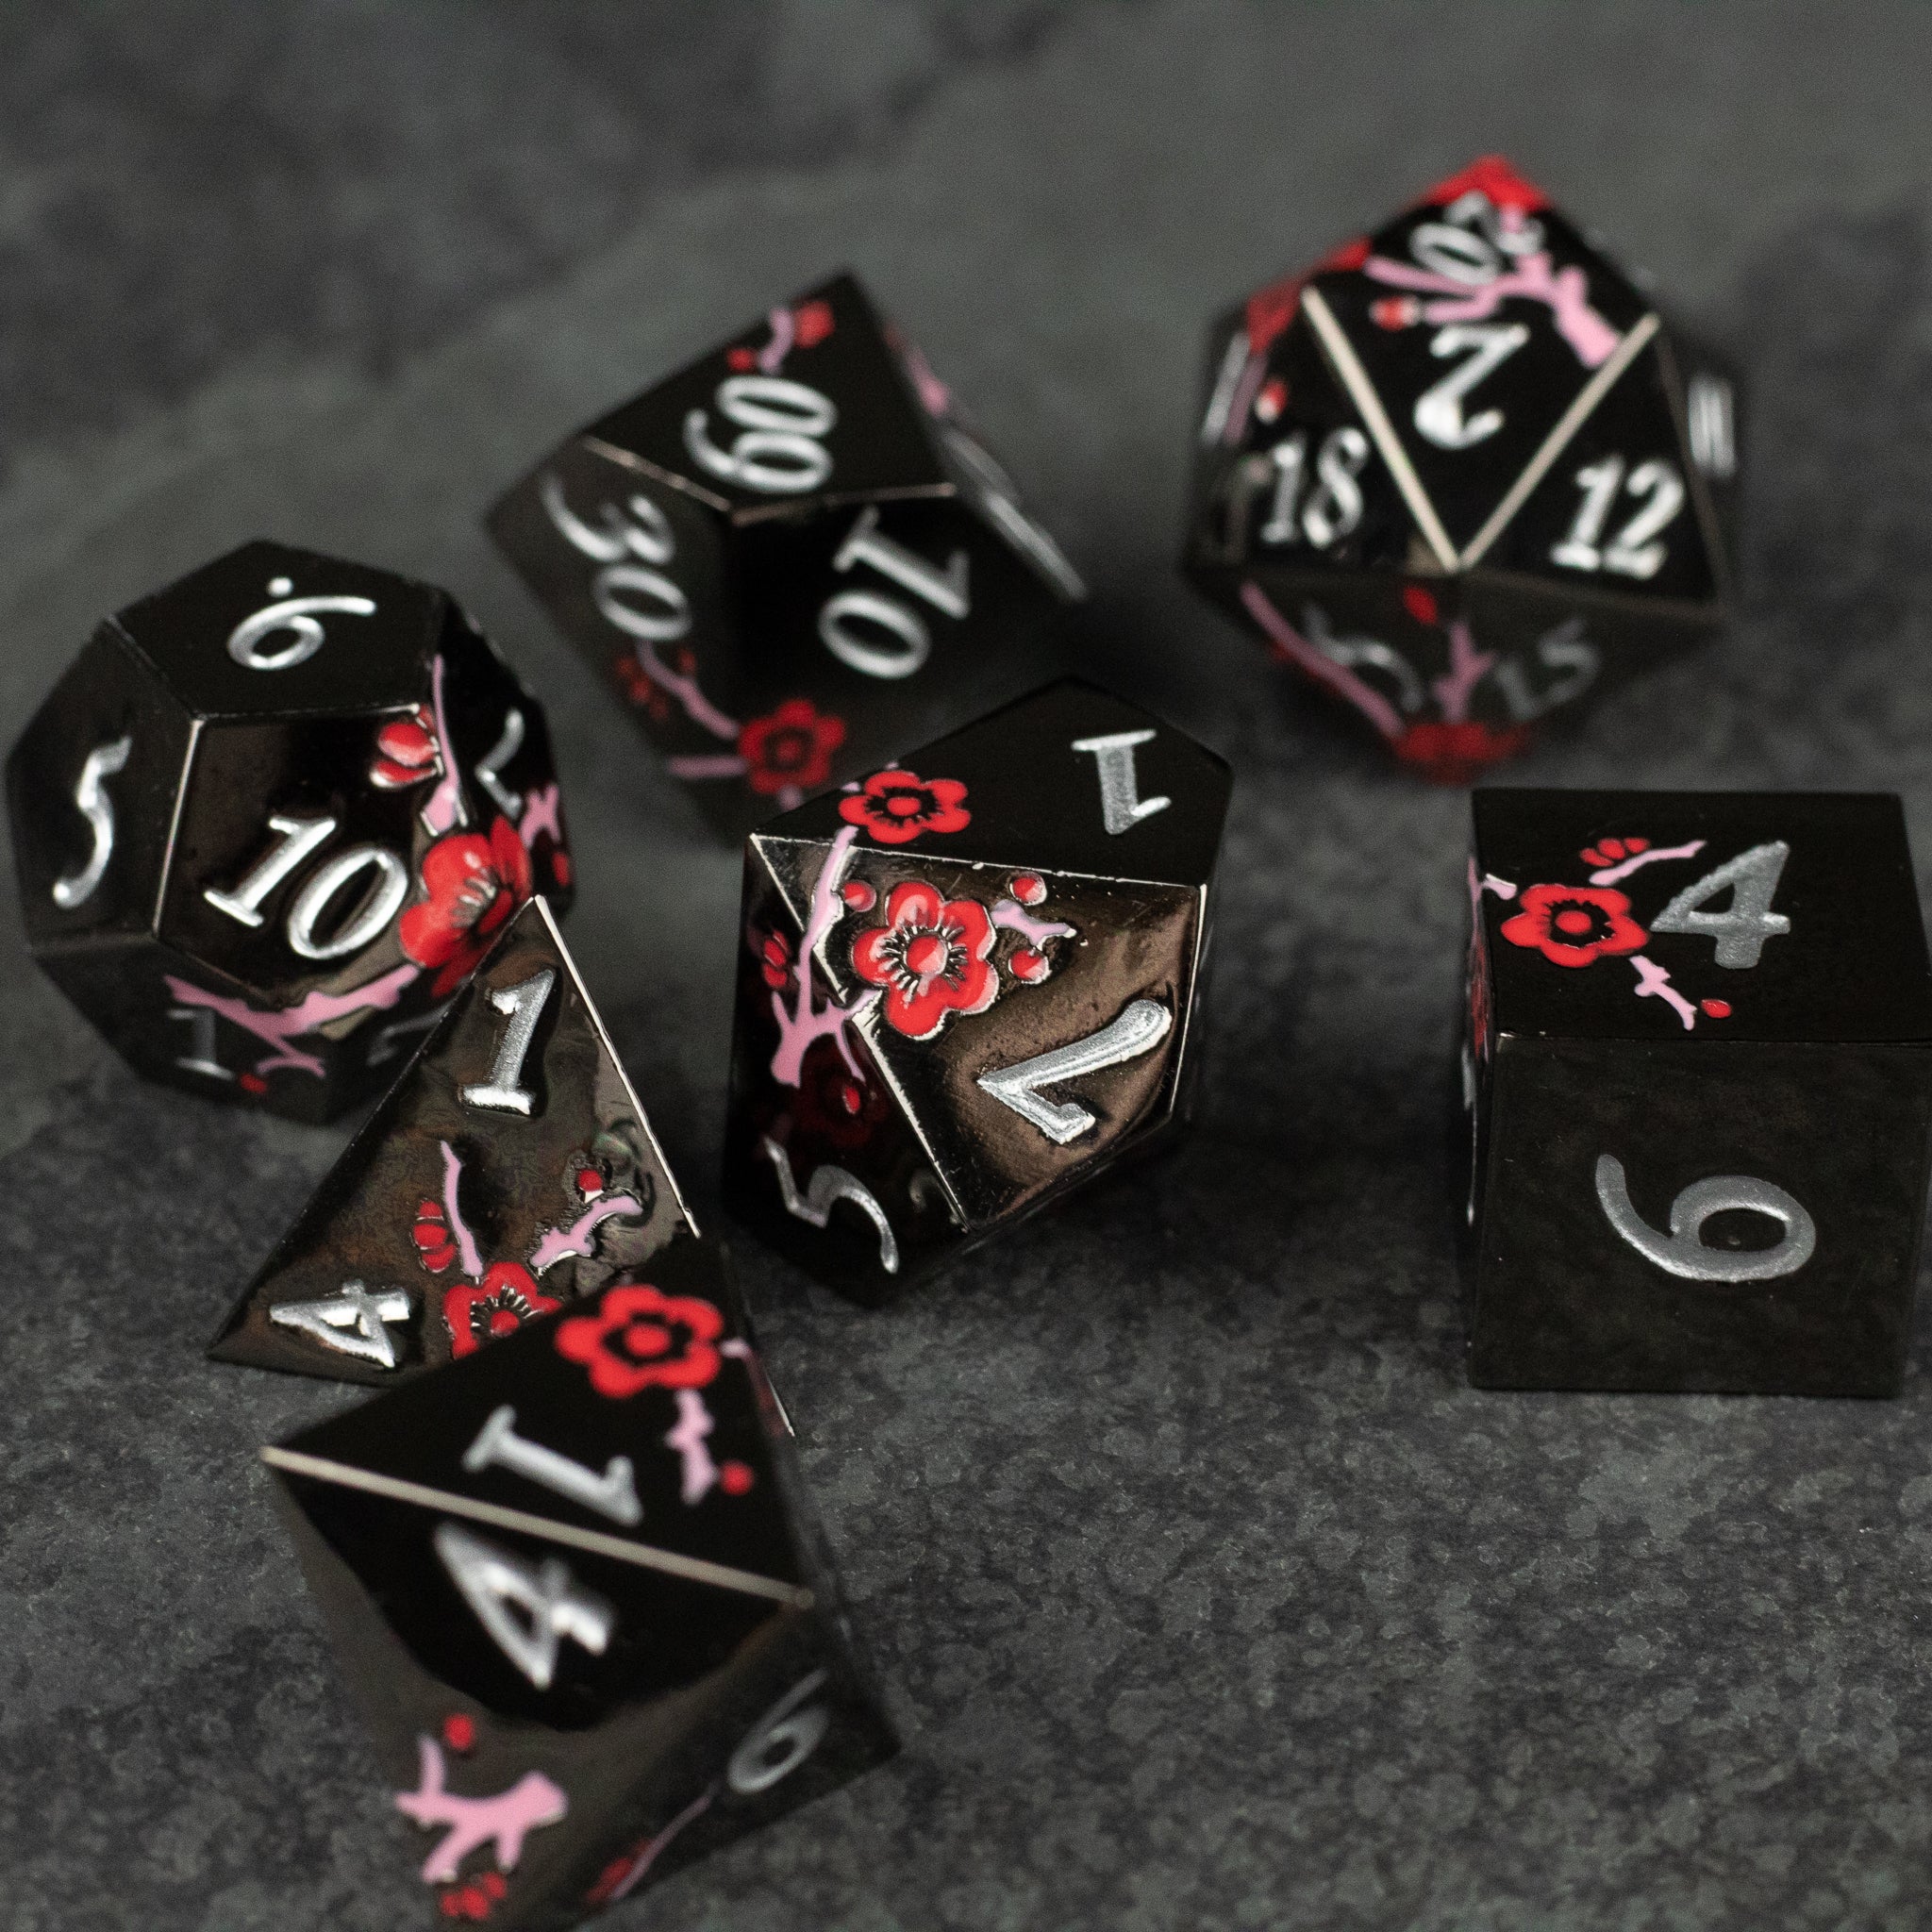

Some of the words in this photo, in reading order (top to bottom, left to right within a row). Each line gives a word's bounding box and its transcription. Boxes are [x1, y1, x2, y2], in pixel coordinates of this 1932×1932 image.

[1413, 323, 1530, 449] 2
[1260, 426, 1372, 549] 18
[1550, 456, 1686, 580] 12
[539, 472, 693, 642] 30
[817, 507, 971, 679] 10
[50, 735, 133, 910] 5
[1071, 728, 1172, 836] 1
[203, 815, 409, 961] 10
[1650, 841, 1790, 970] 4
[460, 967, 556, 1116] 1
[976, 998, 1173, 1144] 7
[764, 1134, 900, 1275] 5
[1595, 1154, 1817, 1283] 6
[269, 1280, 412, 1369] 4
[463, 1405, 643, 1527] 1
[433, 1520, 613, 1690] 4
[728, 1669, 831, 1793] 6
